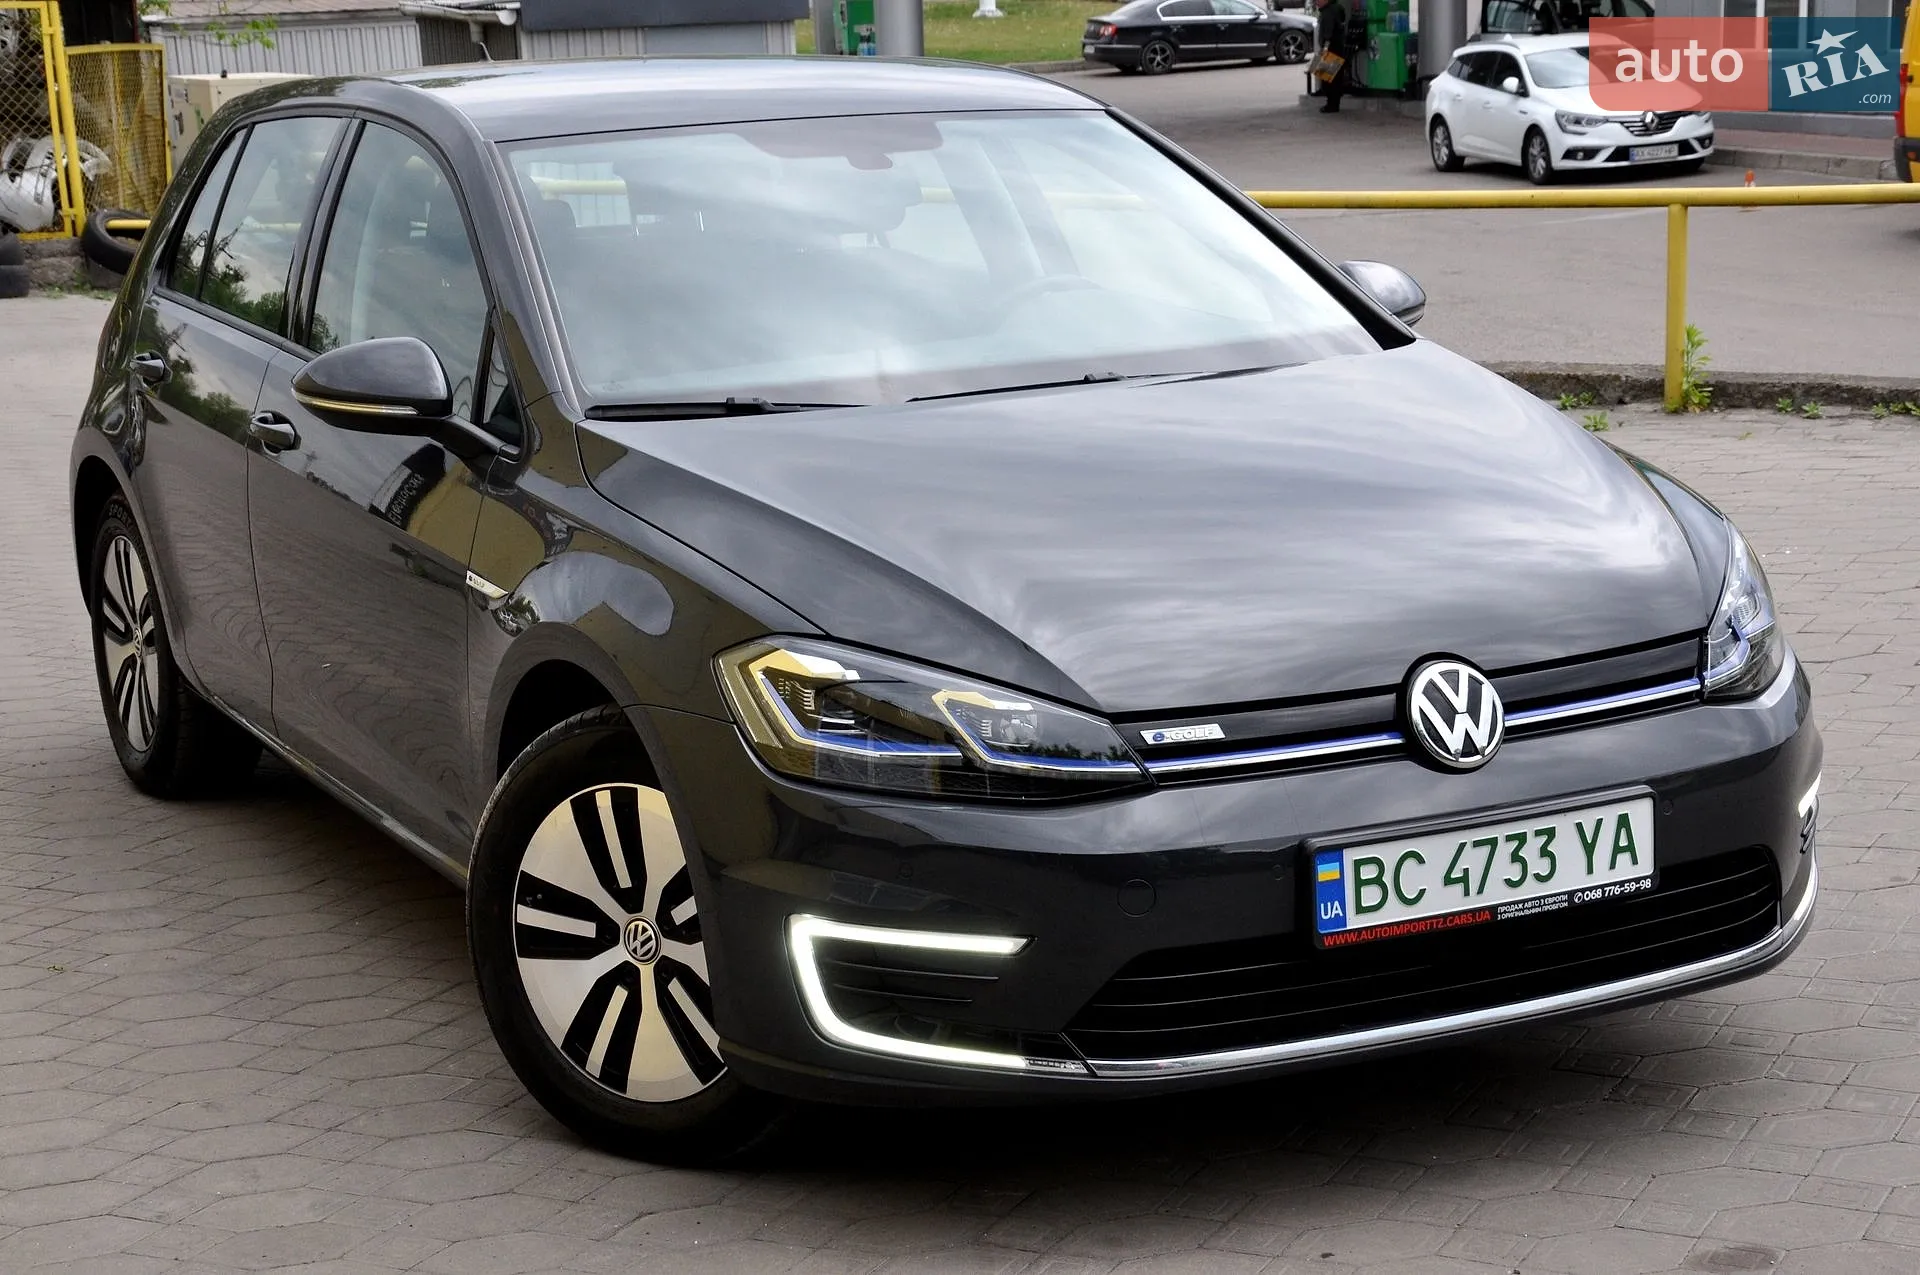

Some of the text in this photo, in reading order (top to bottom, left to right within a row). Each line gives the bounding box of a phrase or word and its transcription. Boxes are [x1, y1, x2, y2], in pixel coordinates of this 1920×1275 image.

[1353, 812, 1639, 914] BC 4733 YA
[1584, 878, 1652, 901] 068 776-59-98
[1321, 900, 1343, 920] UA
[1498, 903, 1523, 913] ПРОДАЖ
[1524, 900, 1539, 909] АВТО
[1545, 894, 1568, 905] ЄВРОПИ
